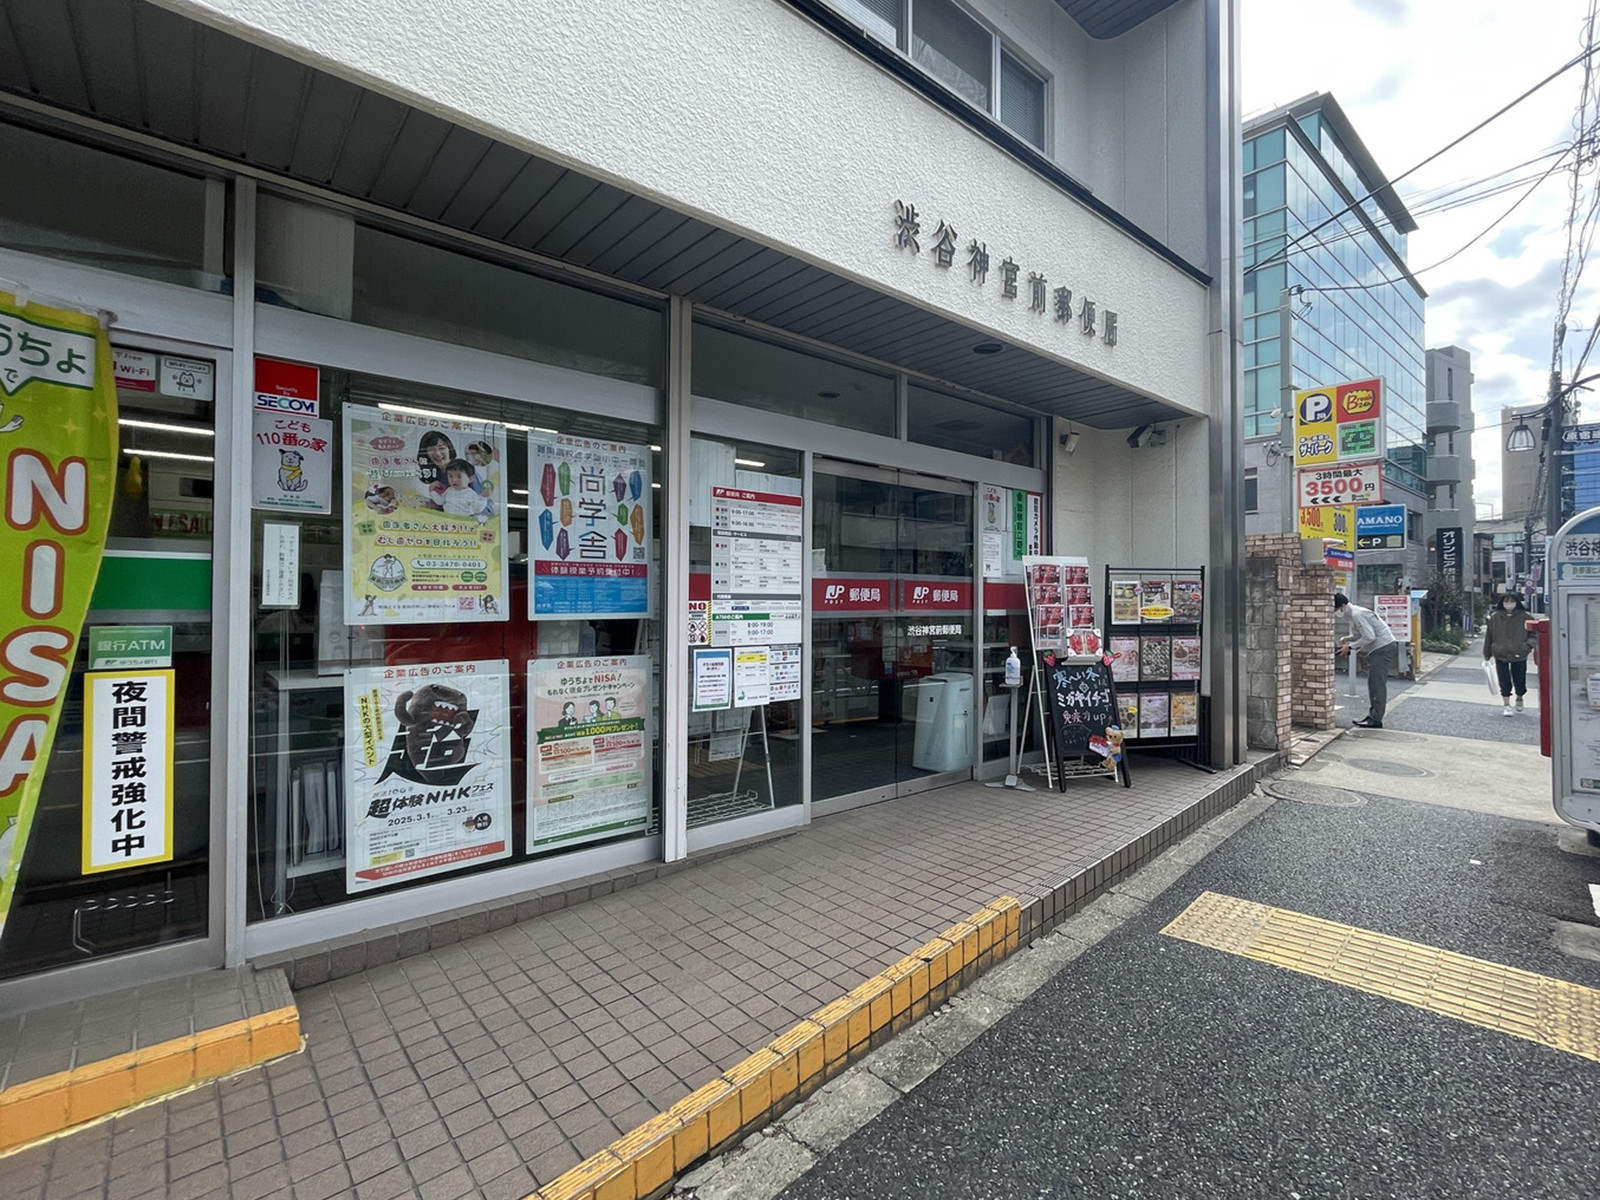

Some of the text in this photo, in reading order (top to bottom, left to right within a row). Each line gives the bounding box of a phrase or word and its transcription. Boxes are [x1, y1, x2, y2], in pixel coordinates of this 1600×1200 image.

[893, 199, 1118, 347] 渋谷神宮前郵便局
[275, 384, 298, 394] Security
[257, 394, 315, 413] SECOM
[1306, 395, 1329, 421] P
[275, 420, 311, 433] こども
[381, 412, 473, 431] 企業広告のご案内
[256, 432, 328, 453] 110番の家
[556, 436, 626, 453] 企業広告のご案内
[1315, 468, 1363, 481] 3時間最大
[578, 466, 608, 560] 尚学舎
[1357, 515, 1402, 525] AMANO
[1372, 538, 1381, 547] P
[849, 587, 881, 602] 郵便局
[932, 589, 958, 603] 郵便局
[907, 624, 963, 636] 渋谷神宮前郵便局
[383, 664, 476, 679] 企業広告のご案内
[557, 658, 627, 670] 企業広告のご案内
[1093, 713, 1107, 726] up
[111, 681, 148, 857] 夜間警戒強化中
